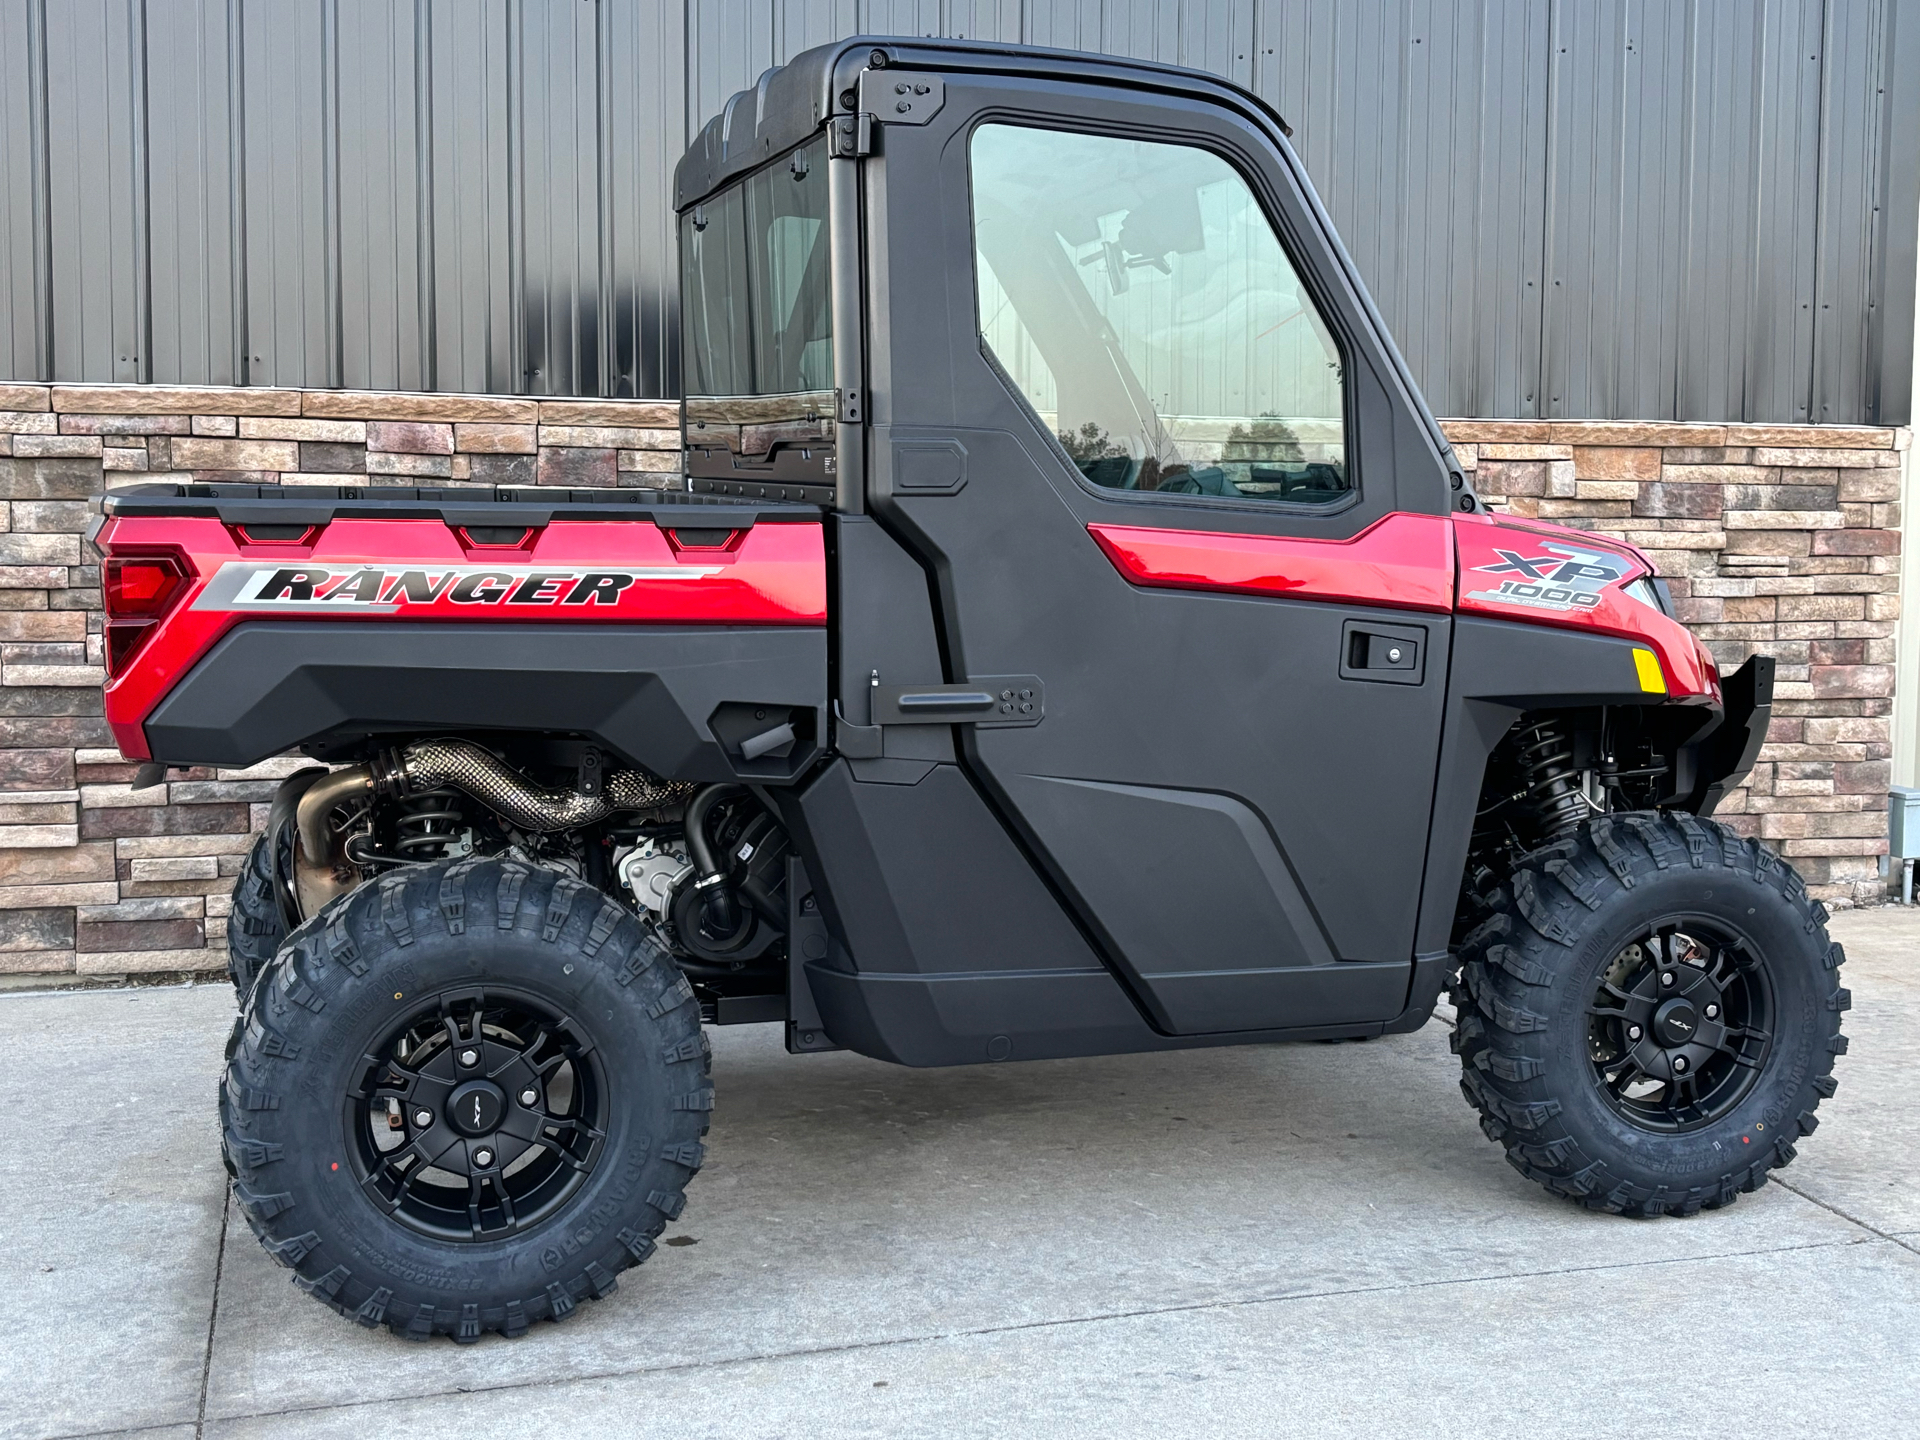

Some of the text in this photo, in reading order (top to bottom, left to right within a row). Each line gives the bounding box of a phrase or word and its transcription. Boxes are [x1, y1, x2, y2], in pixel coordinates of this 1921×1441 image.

[1468, 548, 1623, 583] XP
[254, 568, 635, 606] RANGER
[1499, 580, 1602, 608] 1000
[301, 963, 417, 1100] X-TERRAIN
[1669, 1019, 1692, 1030] XP
[474, 1095, 480, 1128] XP
